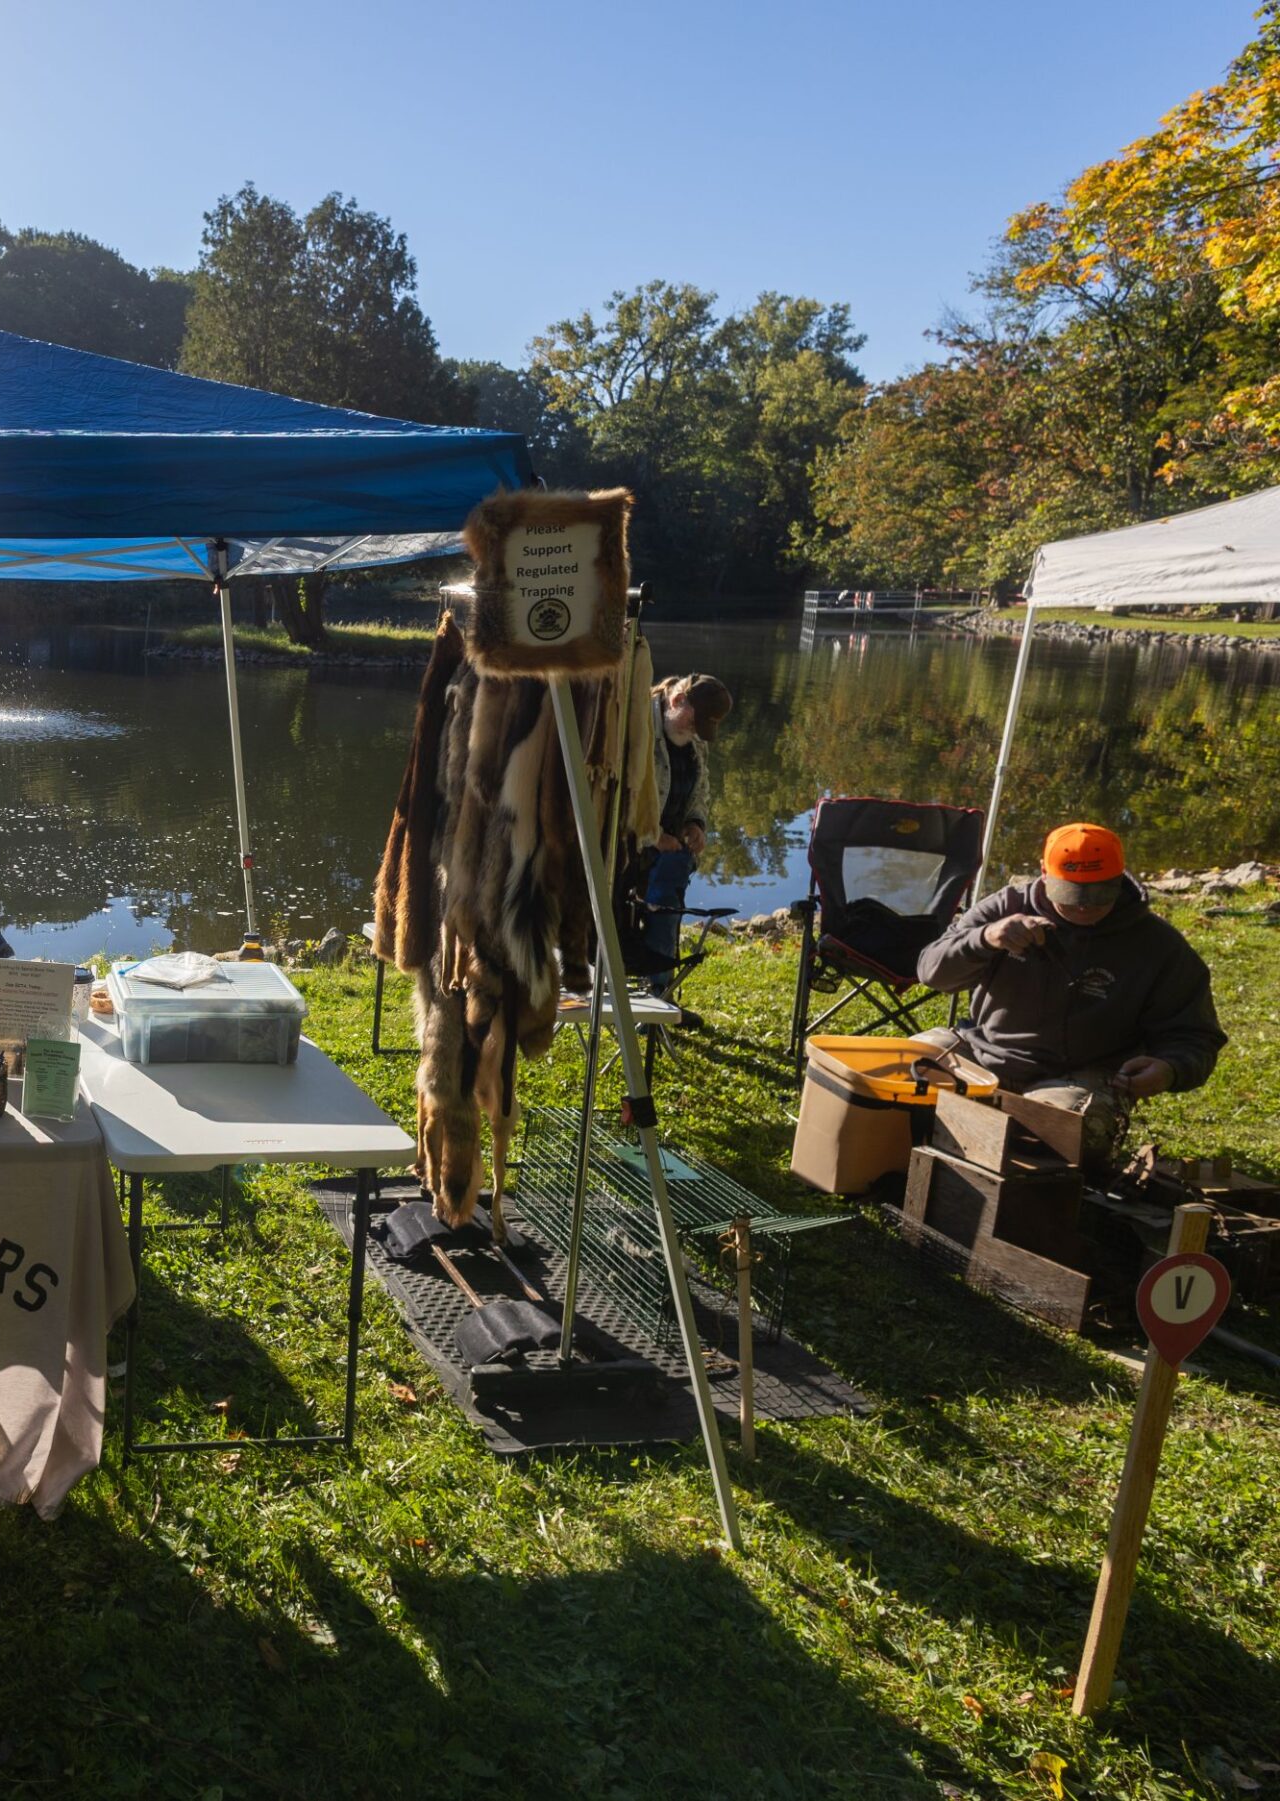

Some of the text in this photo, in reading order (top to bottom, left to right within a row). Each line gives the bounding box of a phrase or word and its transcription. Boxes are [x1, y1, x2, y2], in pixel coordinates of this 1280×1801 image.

[525, 524, 566, 535] Please
[523, 543, 572, 557] Support
[516, 564, 579, 577] Regulated
[519, 585, 574, 599] Trapping
[1175, 1275, 1195, 1310] V
